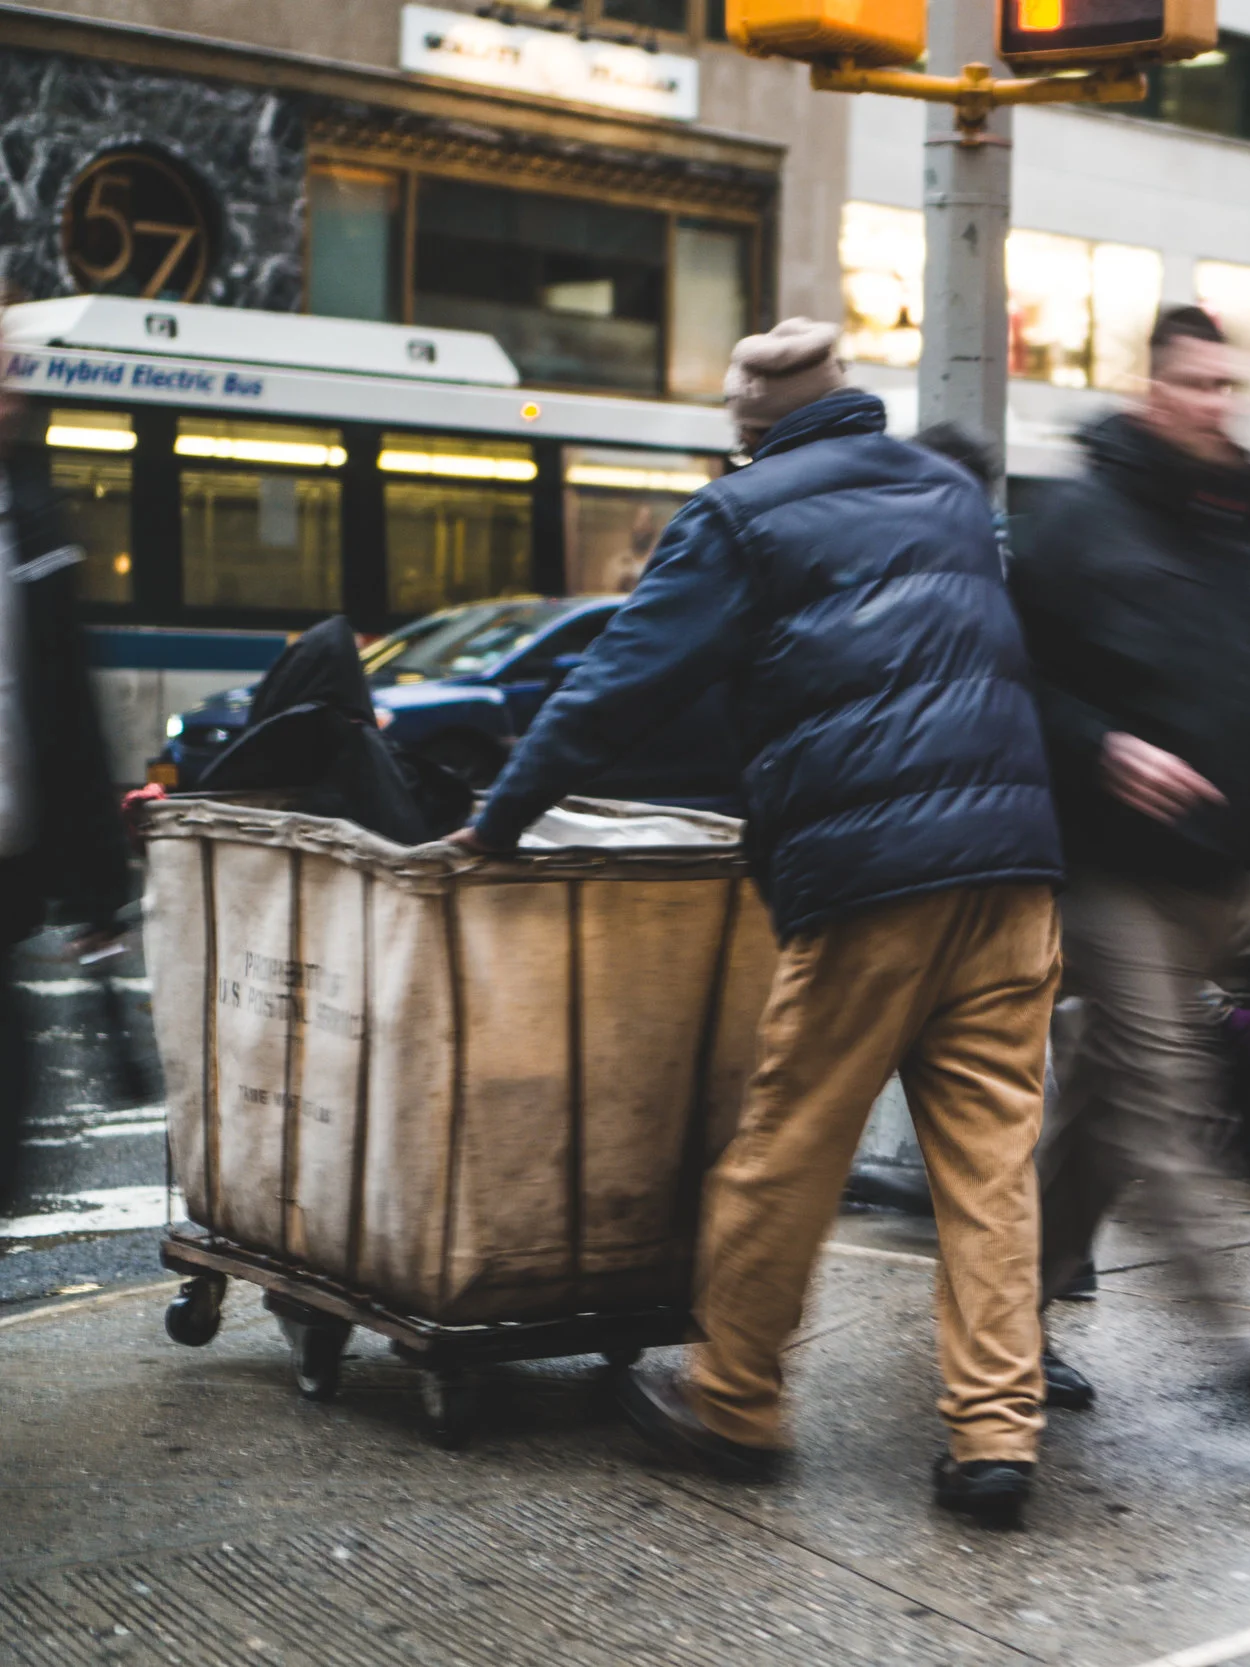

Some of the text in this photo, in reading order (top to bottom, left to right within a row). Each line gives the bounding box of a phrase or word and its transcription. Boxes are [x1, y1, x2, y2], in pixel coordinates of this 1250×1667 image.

[72, 174, 198, 300] 57
[7, 354, 263, 396] Air Hybrid Electric Bus
